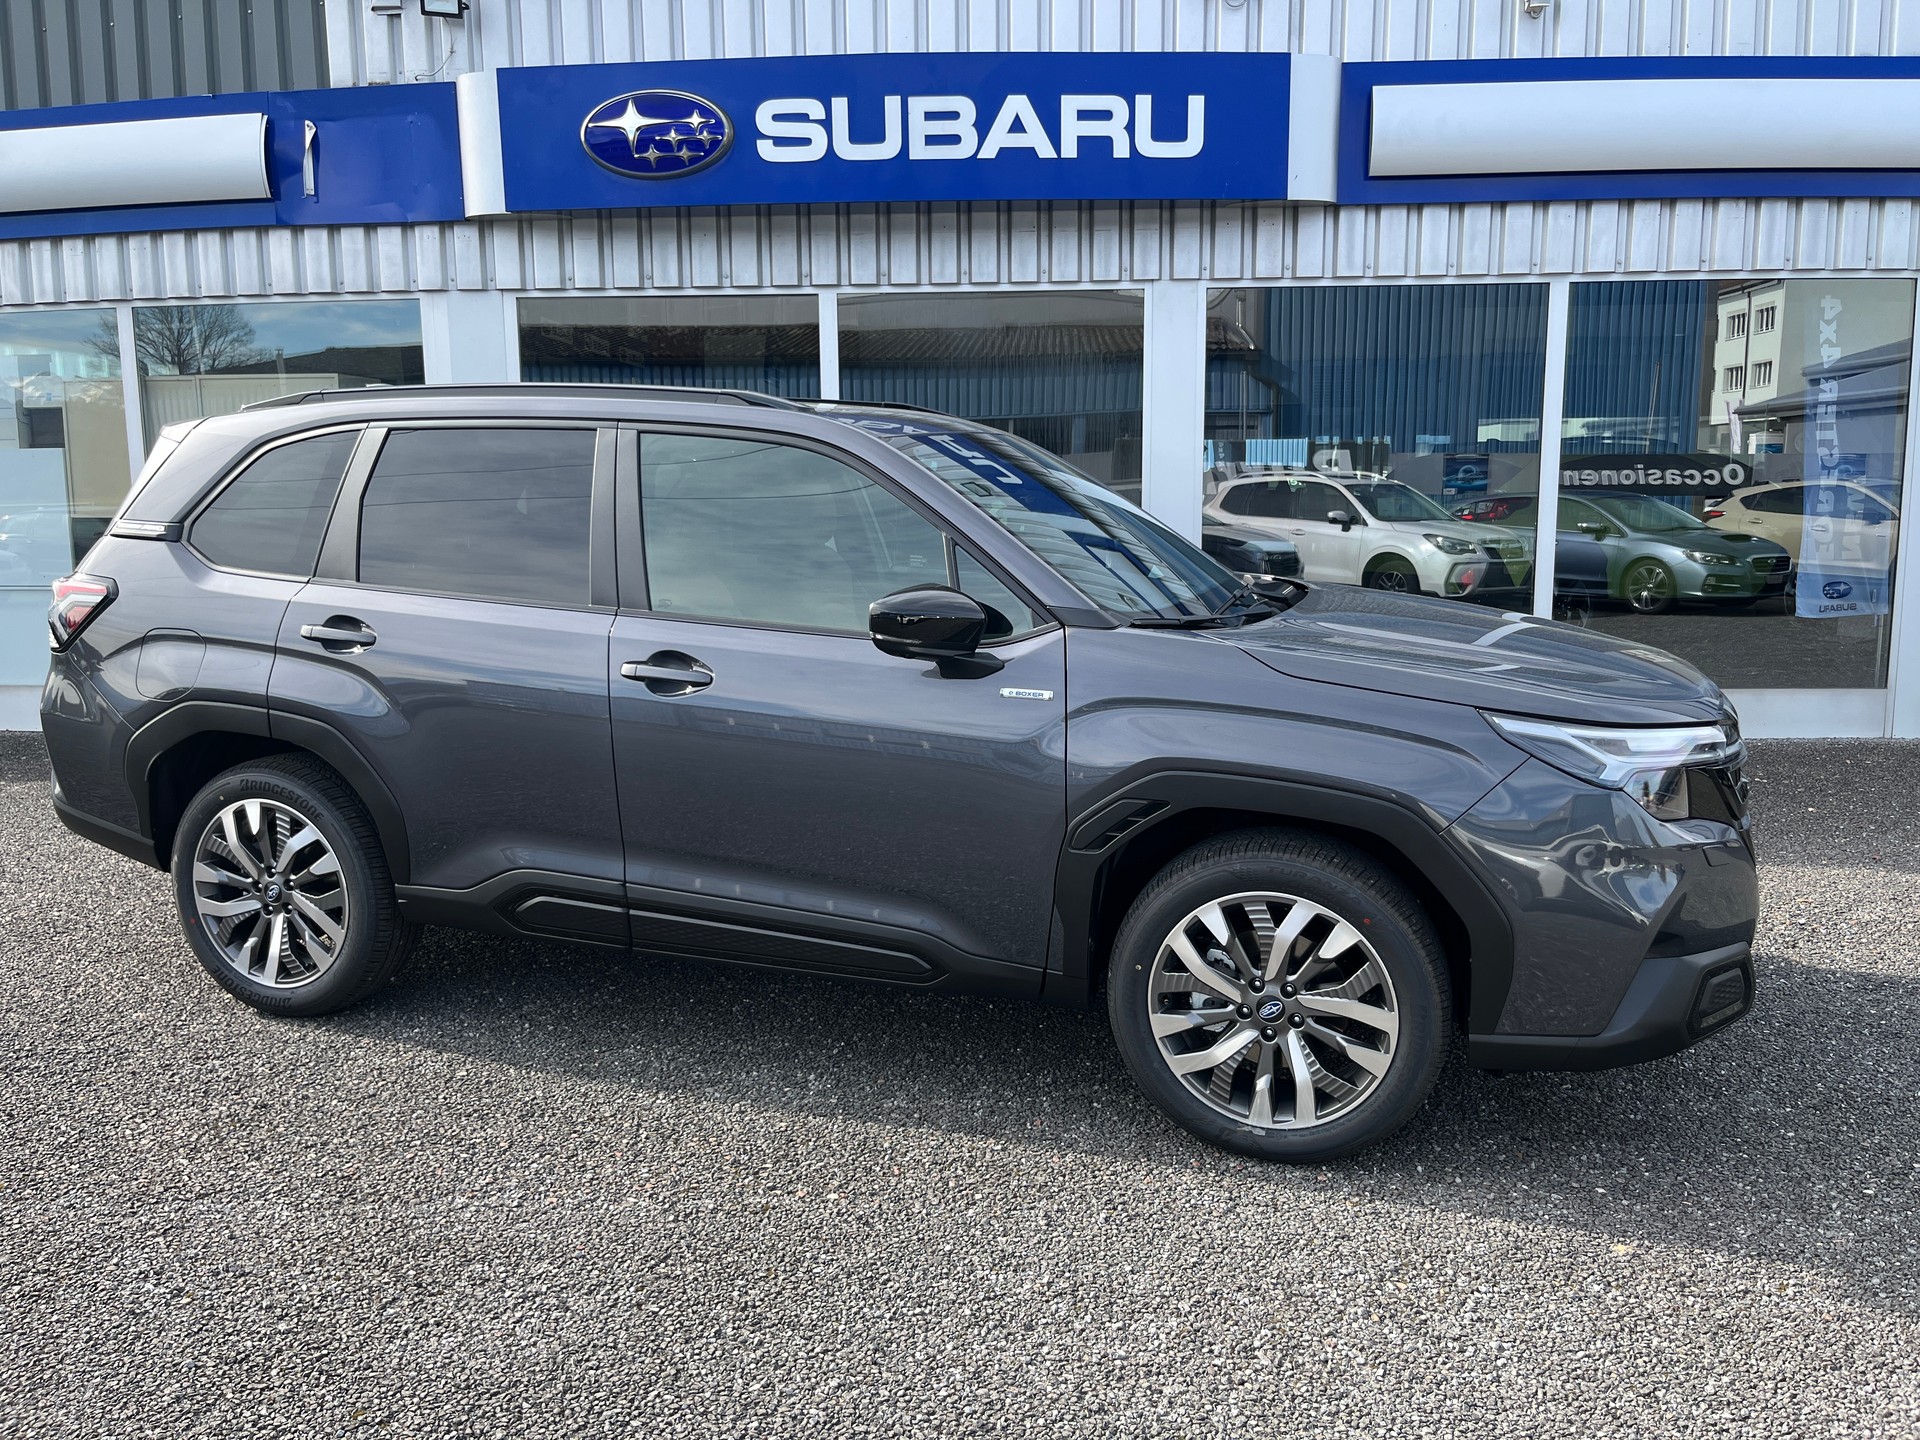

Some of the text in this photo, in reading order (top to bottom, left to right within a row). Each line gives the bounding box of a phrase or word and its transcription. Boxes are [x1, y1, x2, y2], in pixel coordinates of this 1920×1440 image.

[755, 95, 1205, 163] SUBARU
[240, 778, 325, 821] BRIDGESTONE
[210, 965, 293, 1009] BRIDGESTONE
